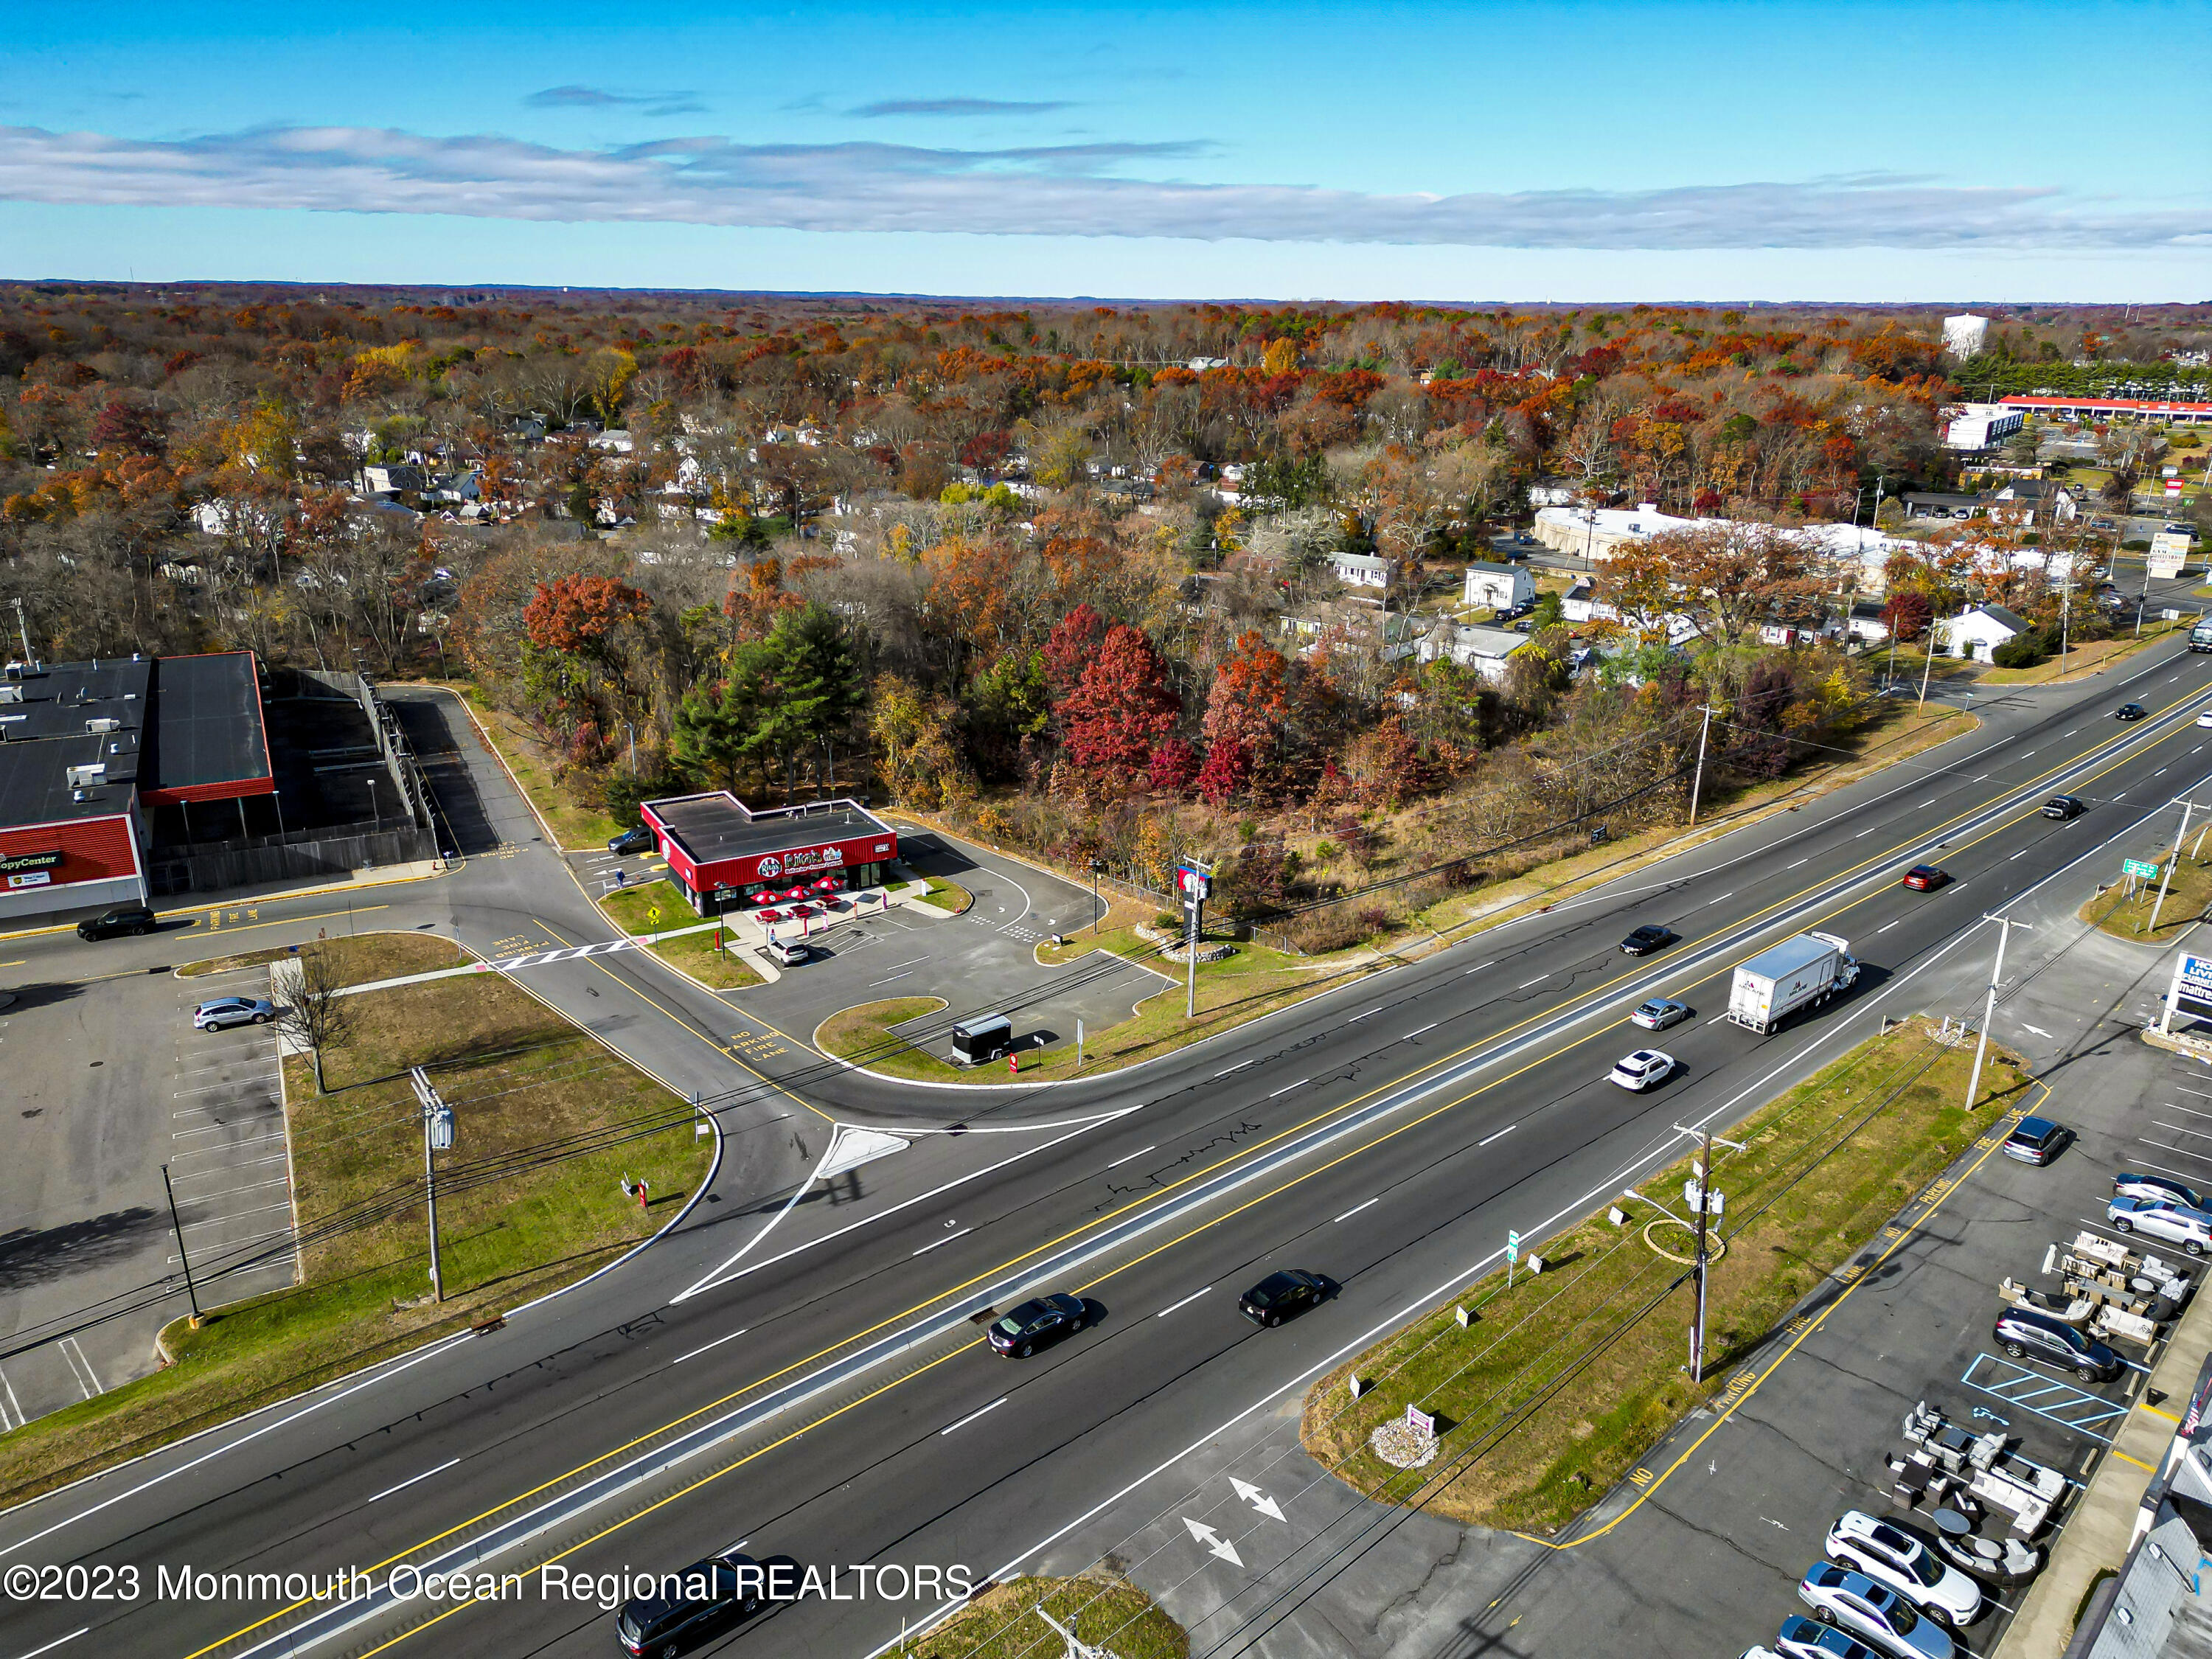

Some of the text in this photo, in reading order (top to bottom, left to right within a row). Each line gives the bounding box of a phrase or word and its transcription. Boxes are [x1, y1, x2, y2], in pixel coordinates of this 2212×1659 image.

[0, 856, 56, 869] opyCenter
[785, 849, 822, 867] Rita's
[491, 934, 525, 946] LANE
[501, 939, 529, 950] FIRE
[495, 940, 550, 958] PARKING
[2180, 983, 2212, 1000] mattre
[722, 1032, 780, 1053] PARKING
[731, 1031, 751, 1040] NO
[744, 1041, 777, 1054] FIRE
[752, 1047, 790, 1062] LANE
[1882, 1107, 2026, 1239] NO PARKING FIRE LANE
[1629, 1265, 1865, 1488] NO PARKING FIRE LANE
